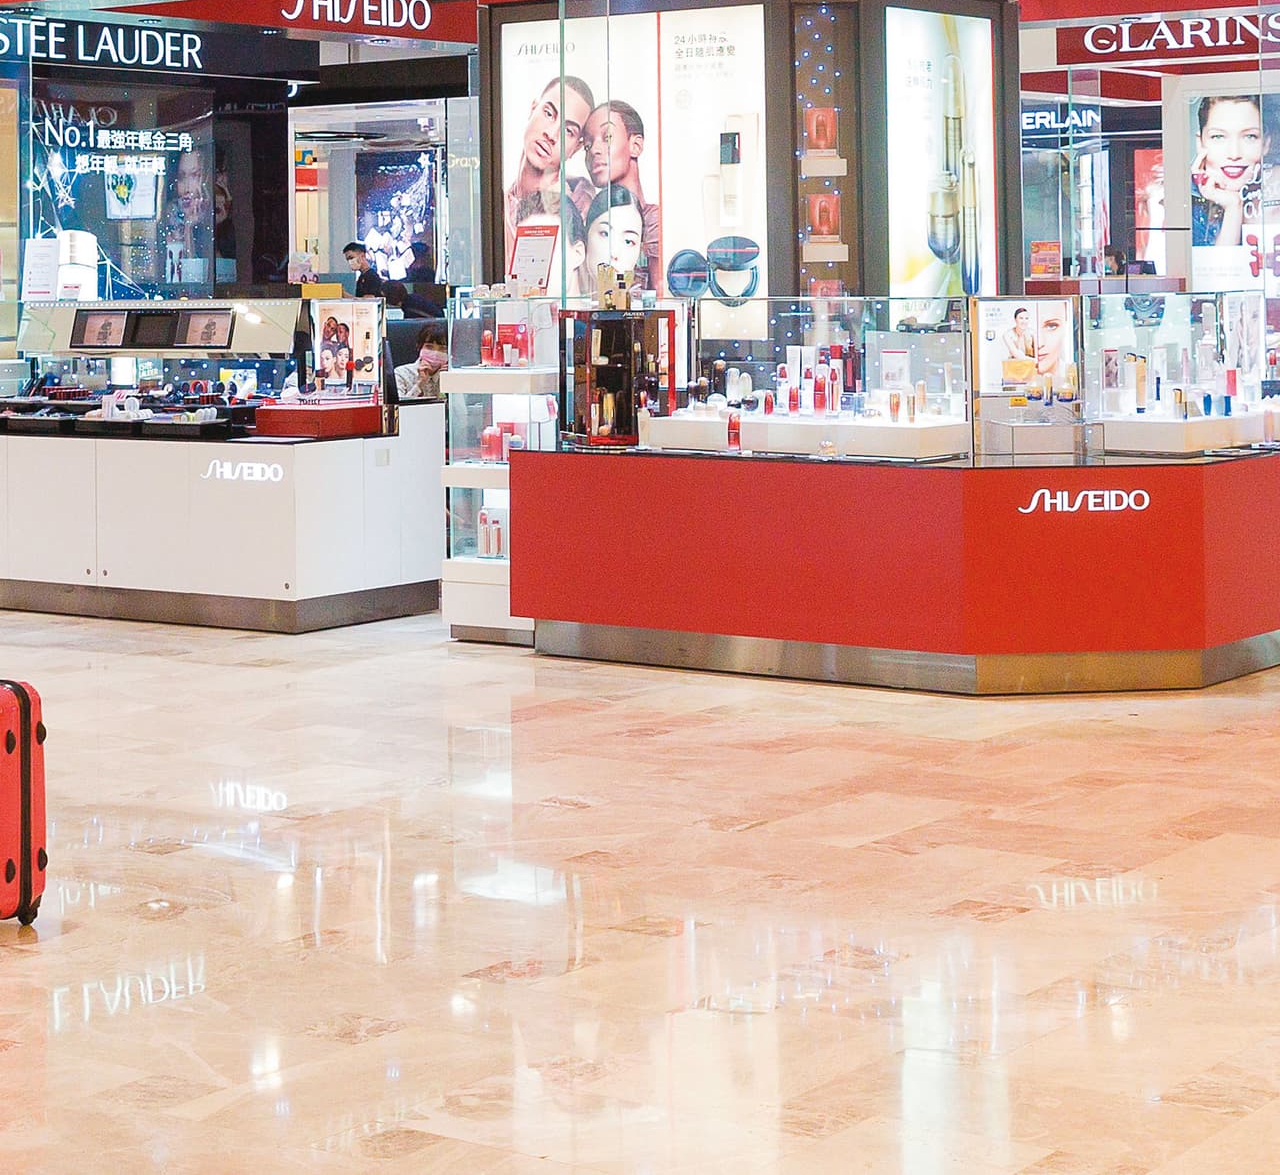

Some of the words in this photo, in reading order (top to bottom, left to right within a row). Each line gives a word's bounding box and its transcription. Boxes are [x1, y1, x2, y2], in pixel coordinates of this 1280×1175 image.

[77, 24, 203, 69] LAUDER
[1021, 108, 1101, 130] ERLAIN
[43, 118, 95, 148] No.1
[200, 459, 284, 482] SHISEIDO
[1017, 488, 1151, 514] SHISEIDO
